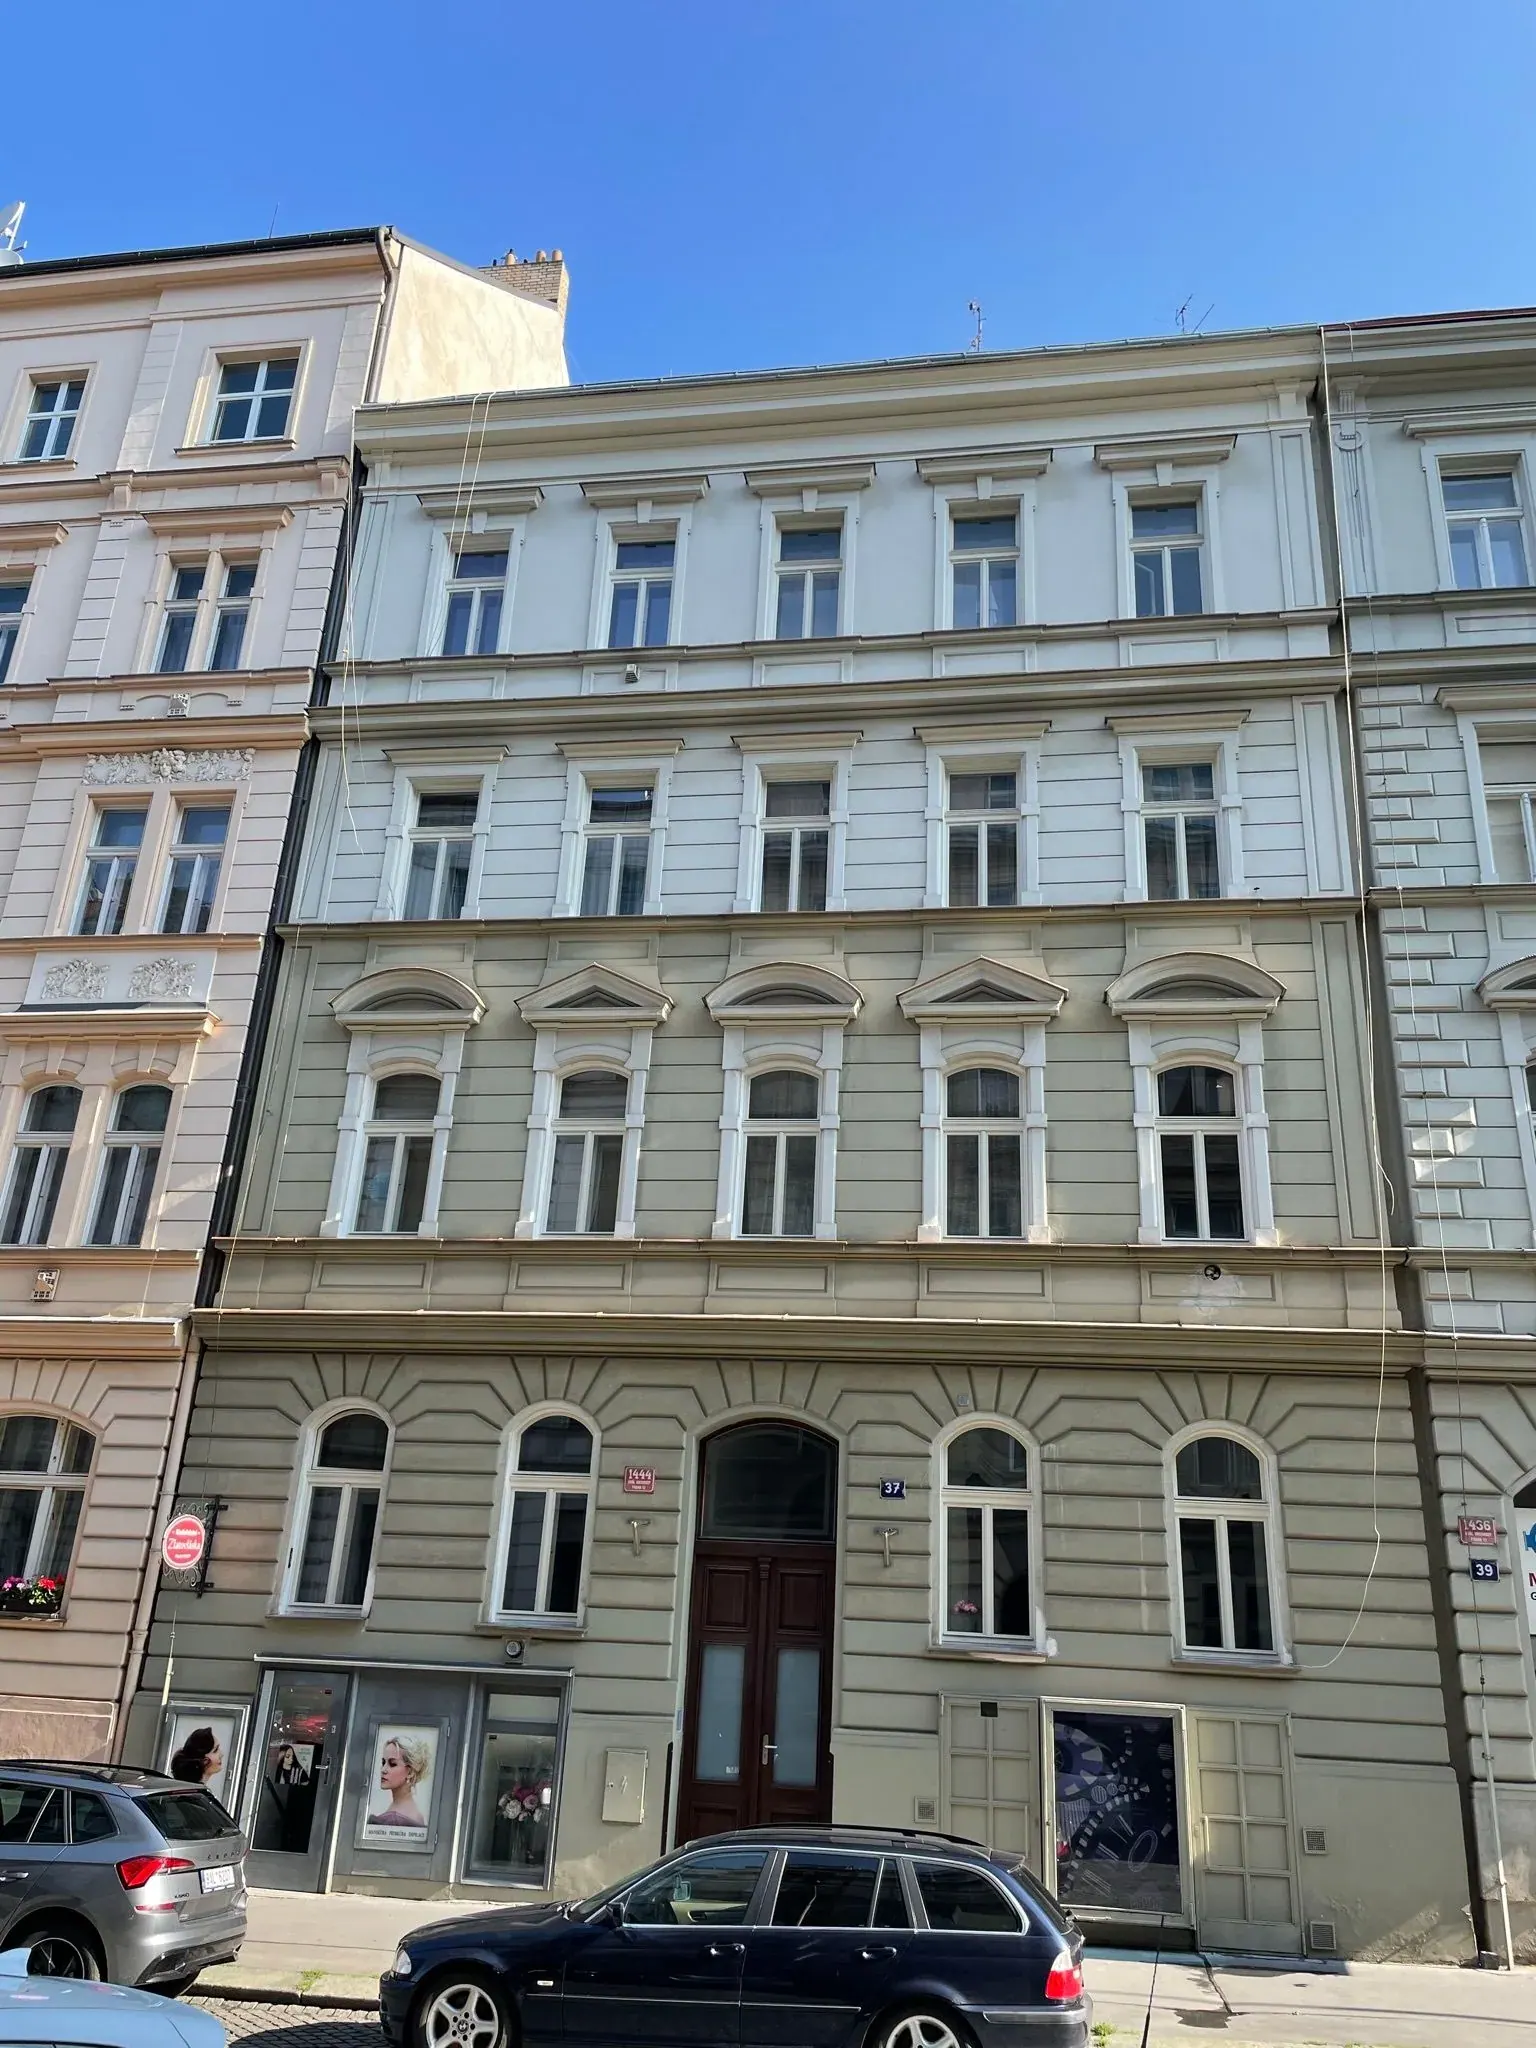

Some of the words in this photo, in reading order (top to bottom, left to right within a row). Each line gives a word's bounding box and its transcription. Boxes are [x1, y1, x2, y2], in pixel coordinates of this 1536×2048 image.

[628, 1469, 652, 1480] 1444
[885, 1482, 900, 1494] 37
[1475, 1563, 1494, 1577] 39
